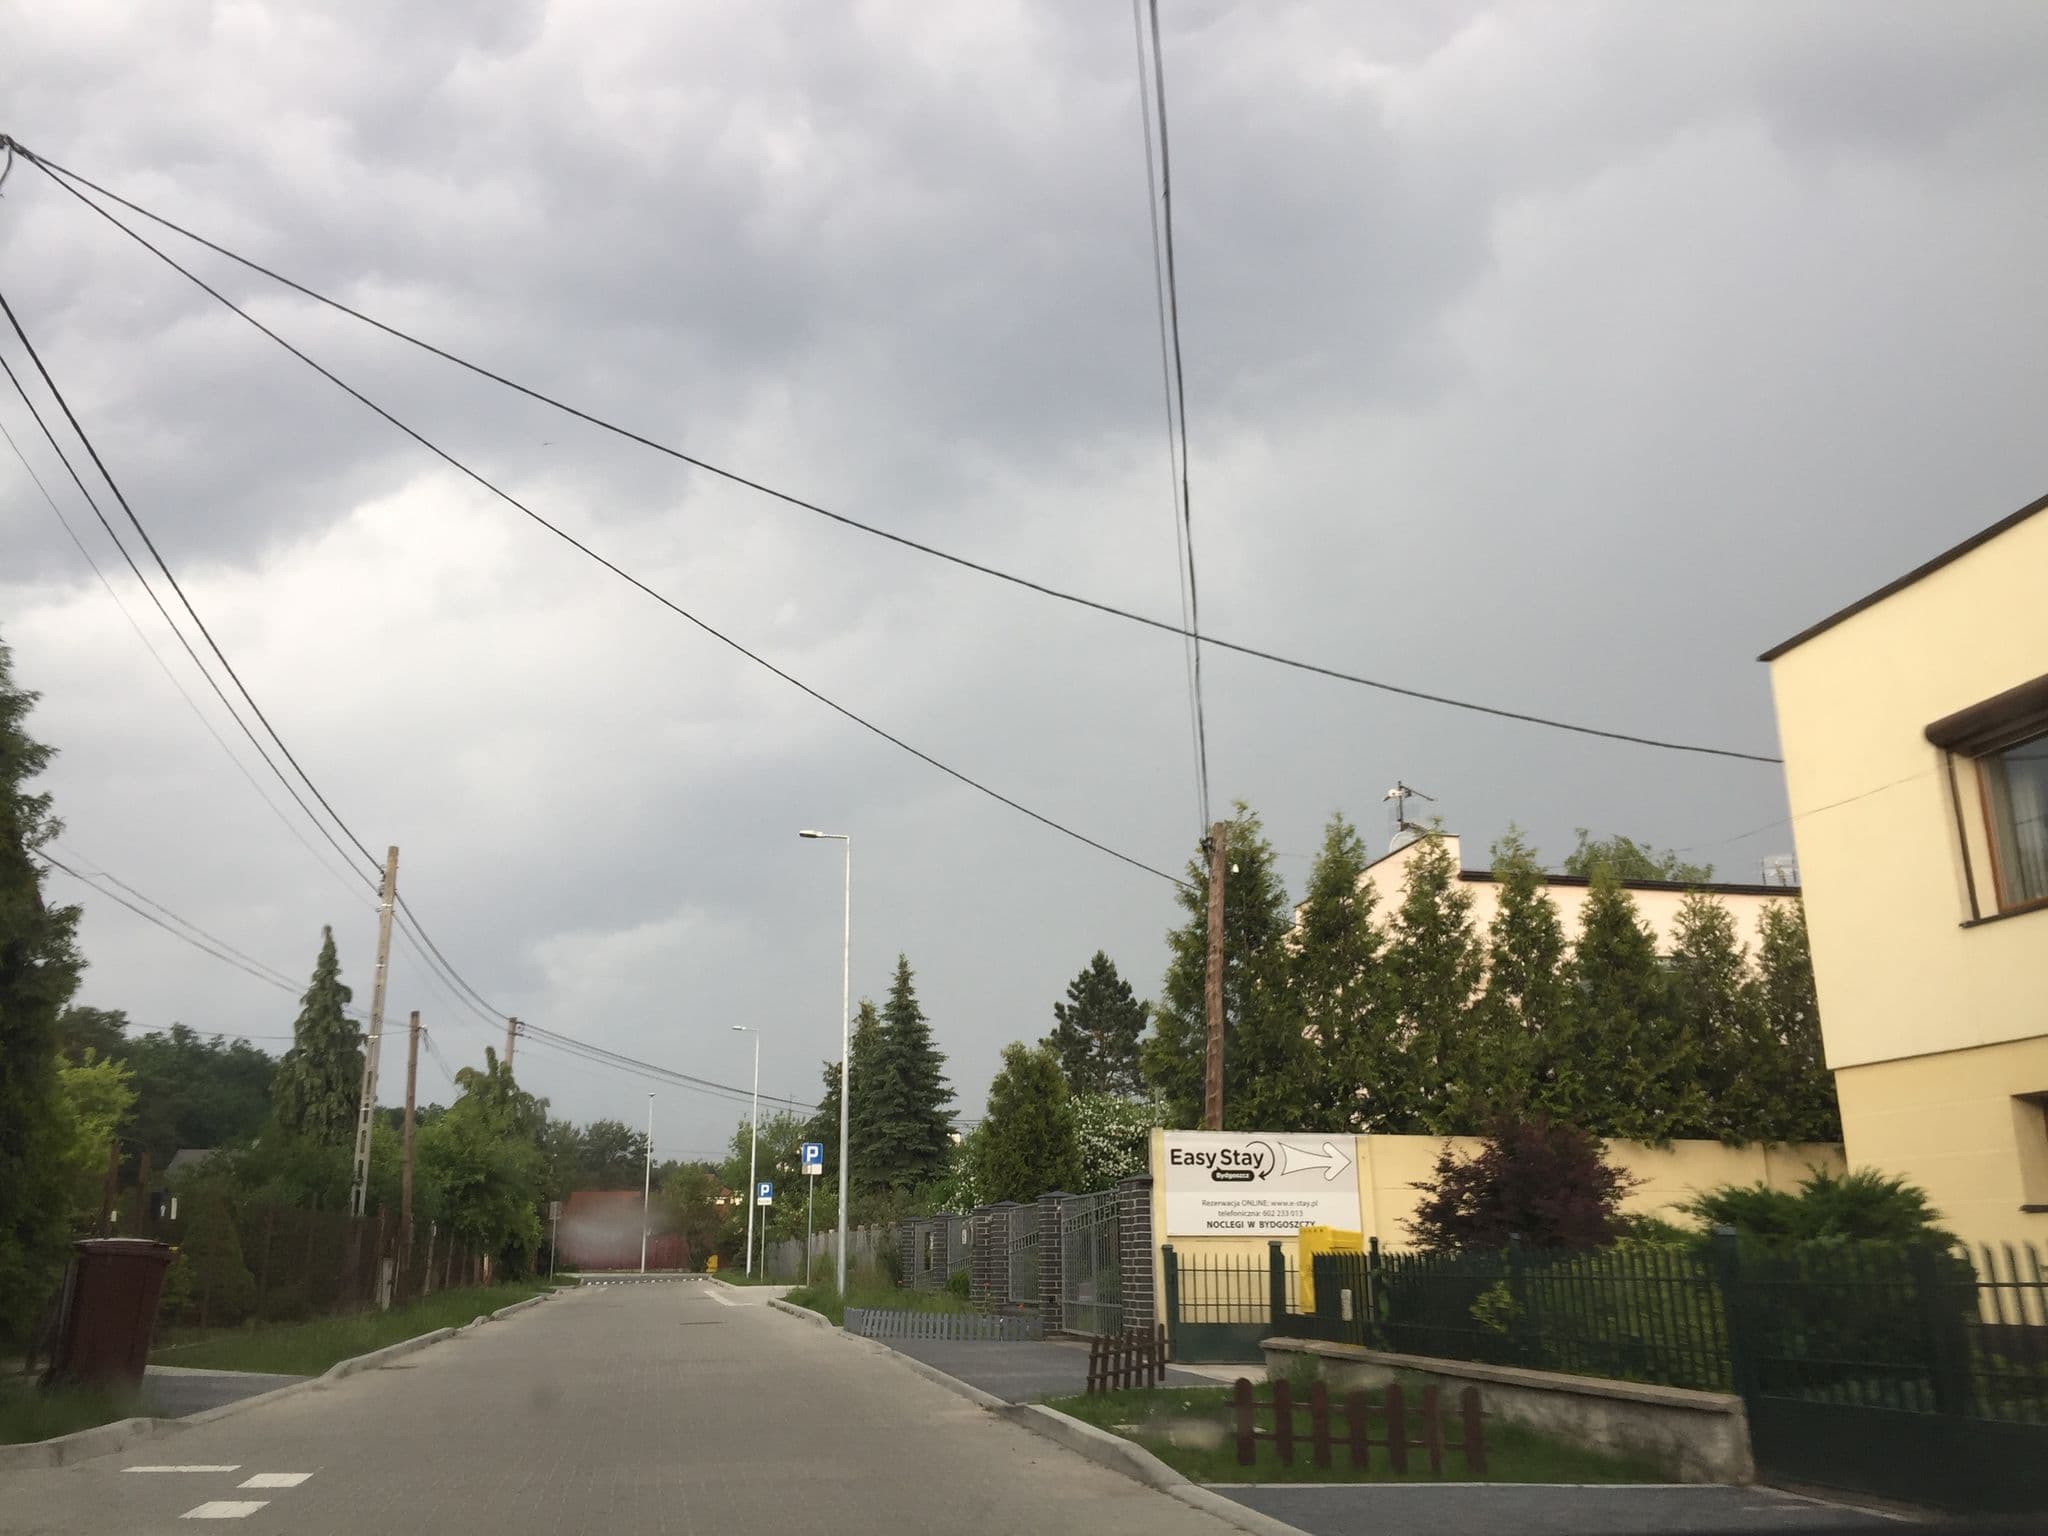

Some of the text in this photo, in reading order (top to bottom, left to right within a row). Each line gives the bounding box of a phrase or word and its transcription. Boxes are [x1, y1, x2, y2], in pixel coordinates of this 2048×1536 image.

[806, 1146, 819, 1162] P
[1170, 1148, 1264, 1169] Easy Stay
[760, 1184, 770, 1196] P
[1201, 1199, 1319, 1208] Rezerwacja ONLINE: www.e-stay.pl
[1206, 1220, 1244, 1229] NOCLEGI
[1247, 1220, 1256, 1229] W
